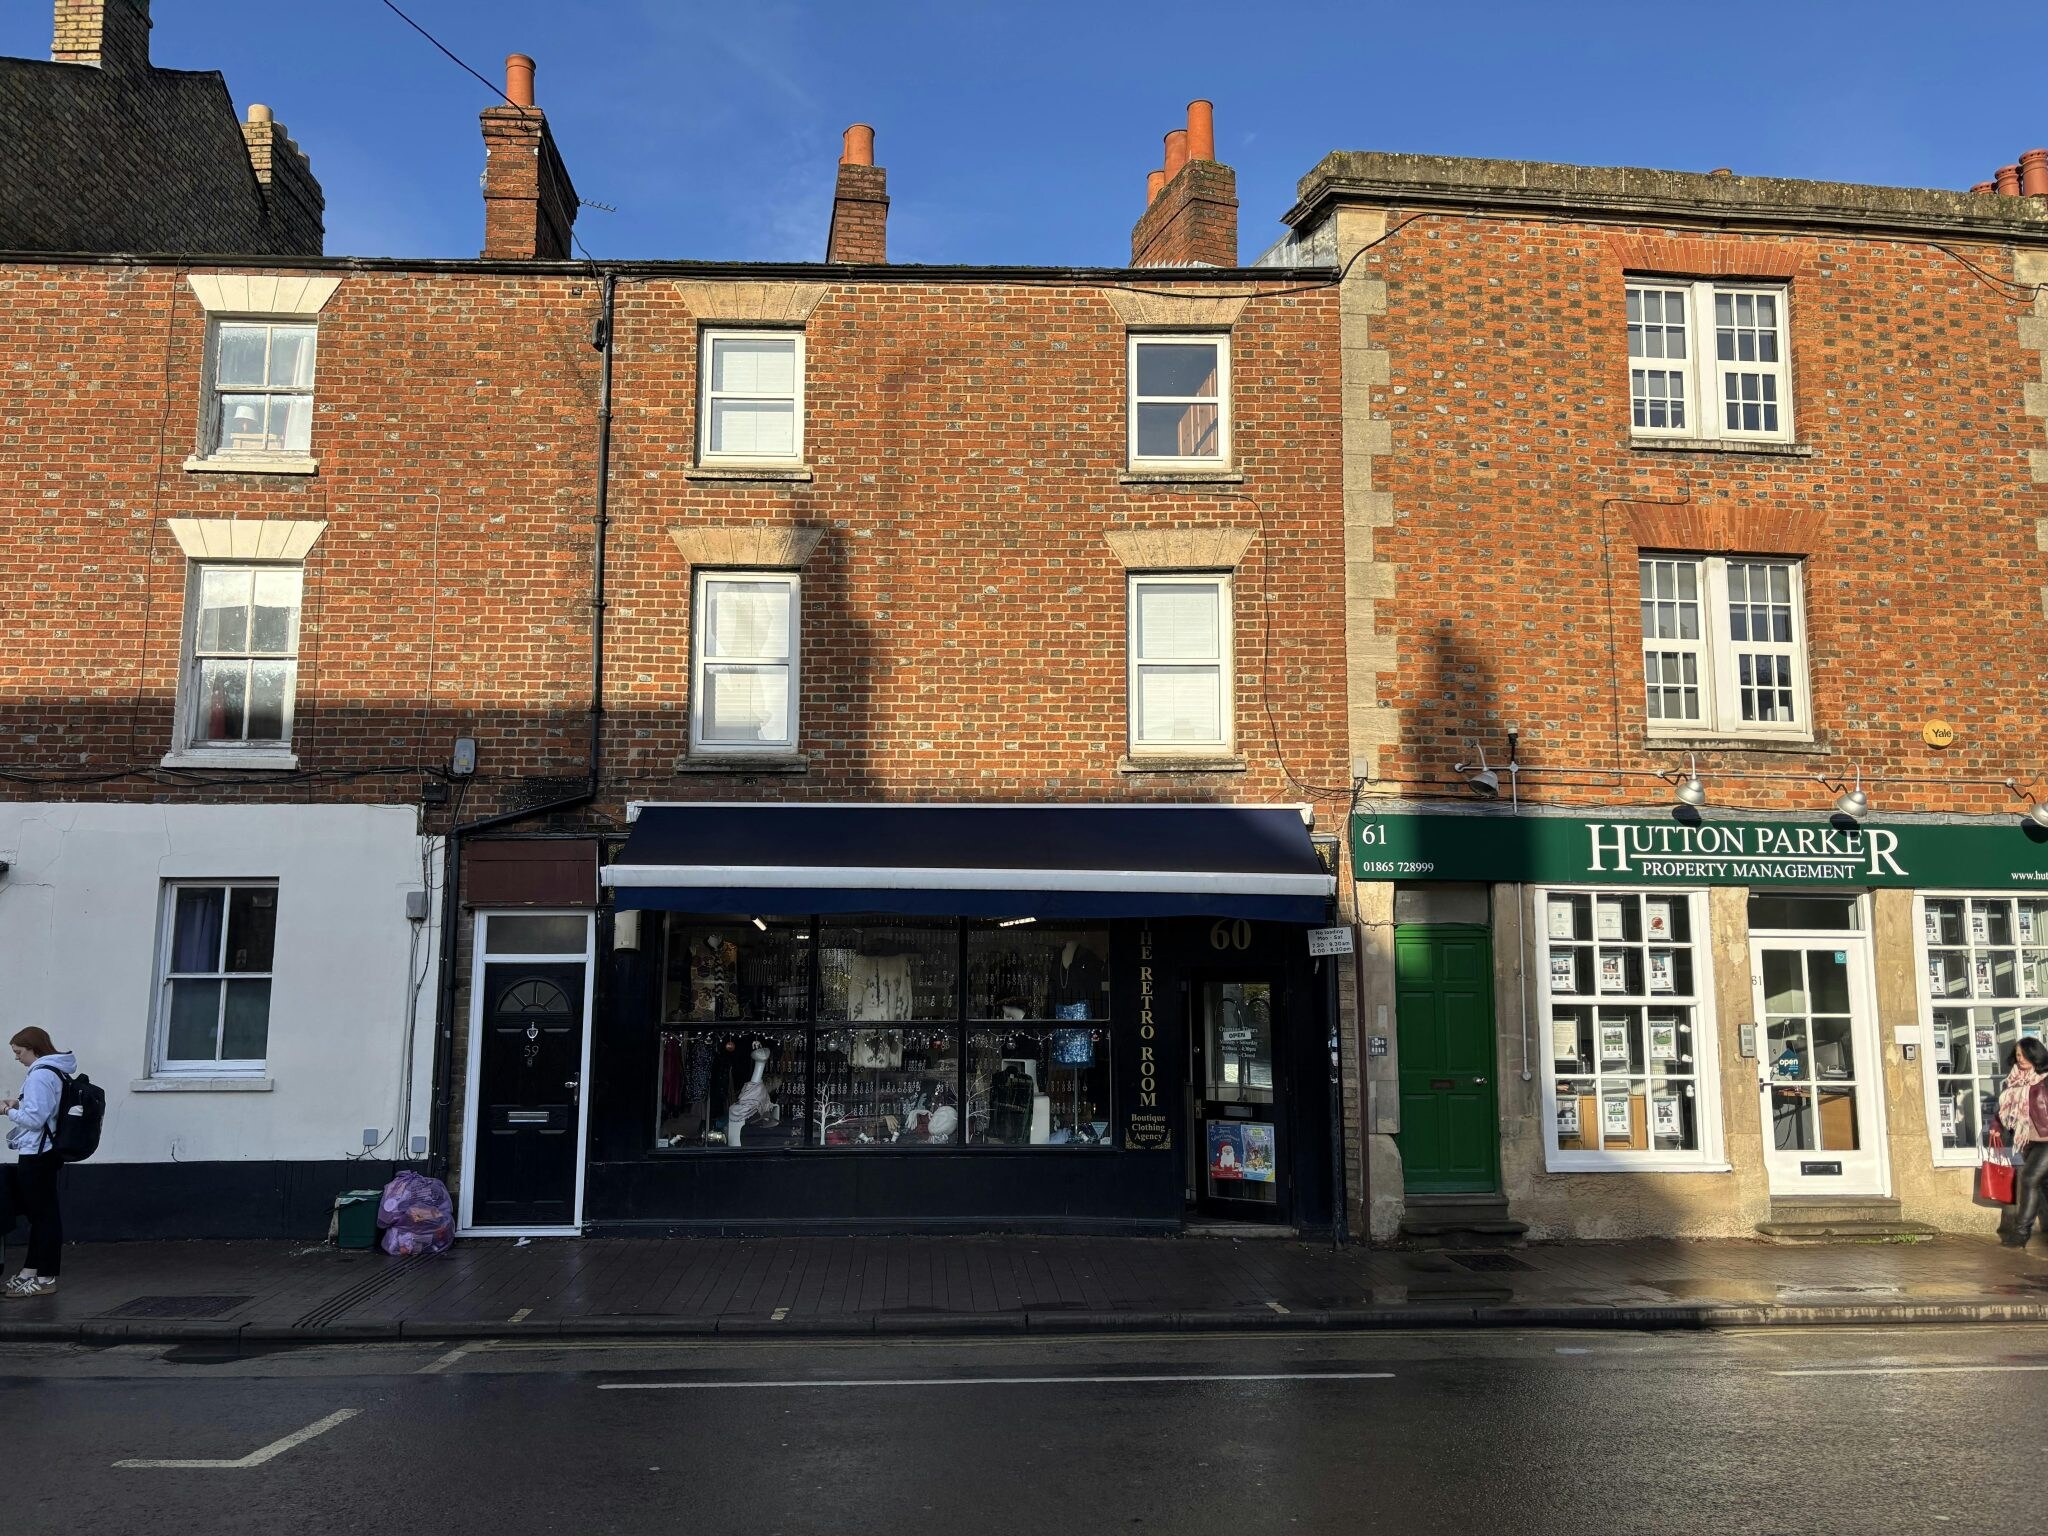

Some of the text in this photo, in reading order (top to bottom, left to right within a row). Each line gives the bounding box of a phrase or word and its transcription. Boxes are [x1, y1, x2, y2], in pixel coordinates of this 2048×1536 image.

[1932, 728, 1952, 738] Yale
[1362, 824, 1387, 845] 61
[1585, 824, 1909, 876] HUTTON PARKER
[1363, 861, 1434, 873] 01865 728999
[1643, 862, 1856, 879] PROPERTY MANAGEMENT
[1210, 919, 1251, 950] 60
[1140, 966, 1154, 1040] RETRO
[524, 1045, 539, 1057] 59
[1779, 1058, 1799, 1067] open
[1140, 1046, 1157, 1107] ROOM
[1131, 1113, 1166, 1123] Boutique
[1131, 1123, 1166, 1132] Clothing
[1134, 1132, 1163, 1142] Agency
